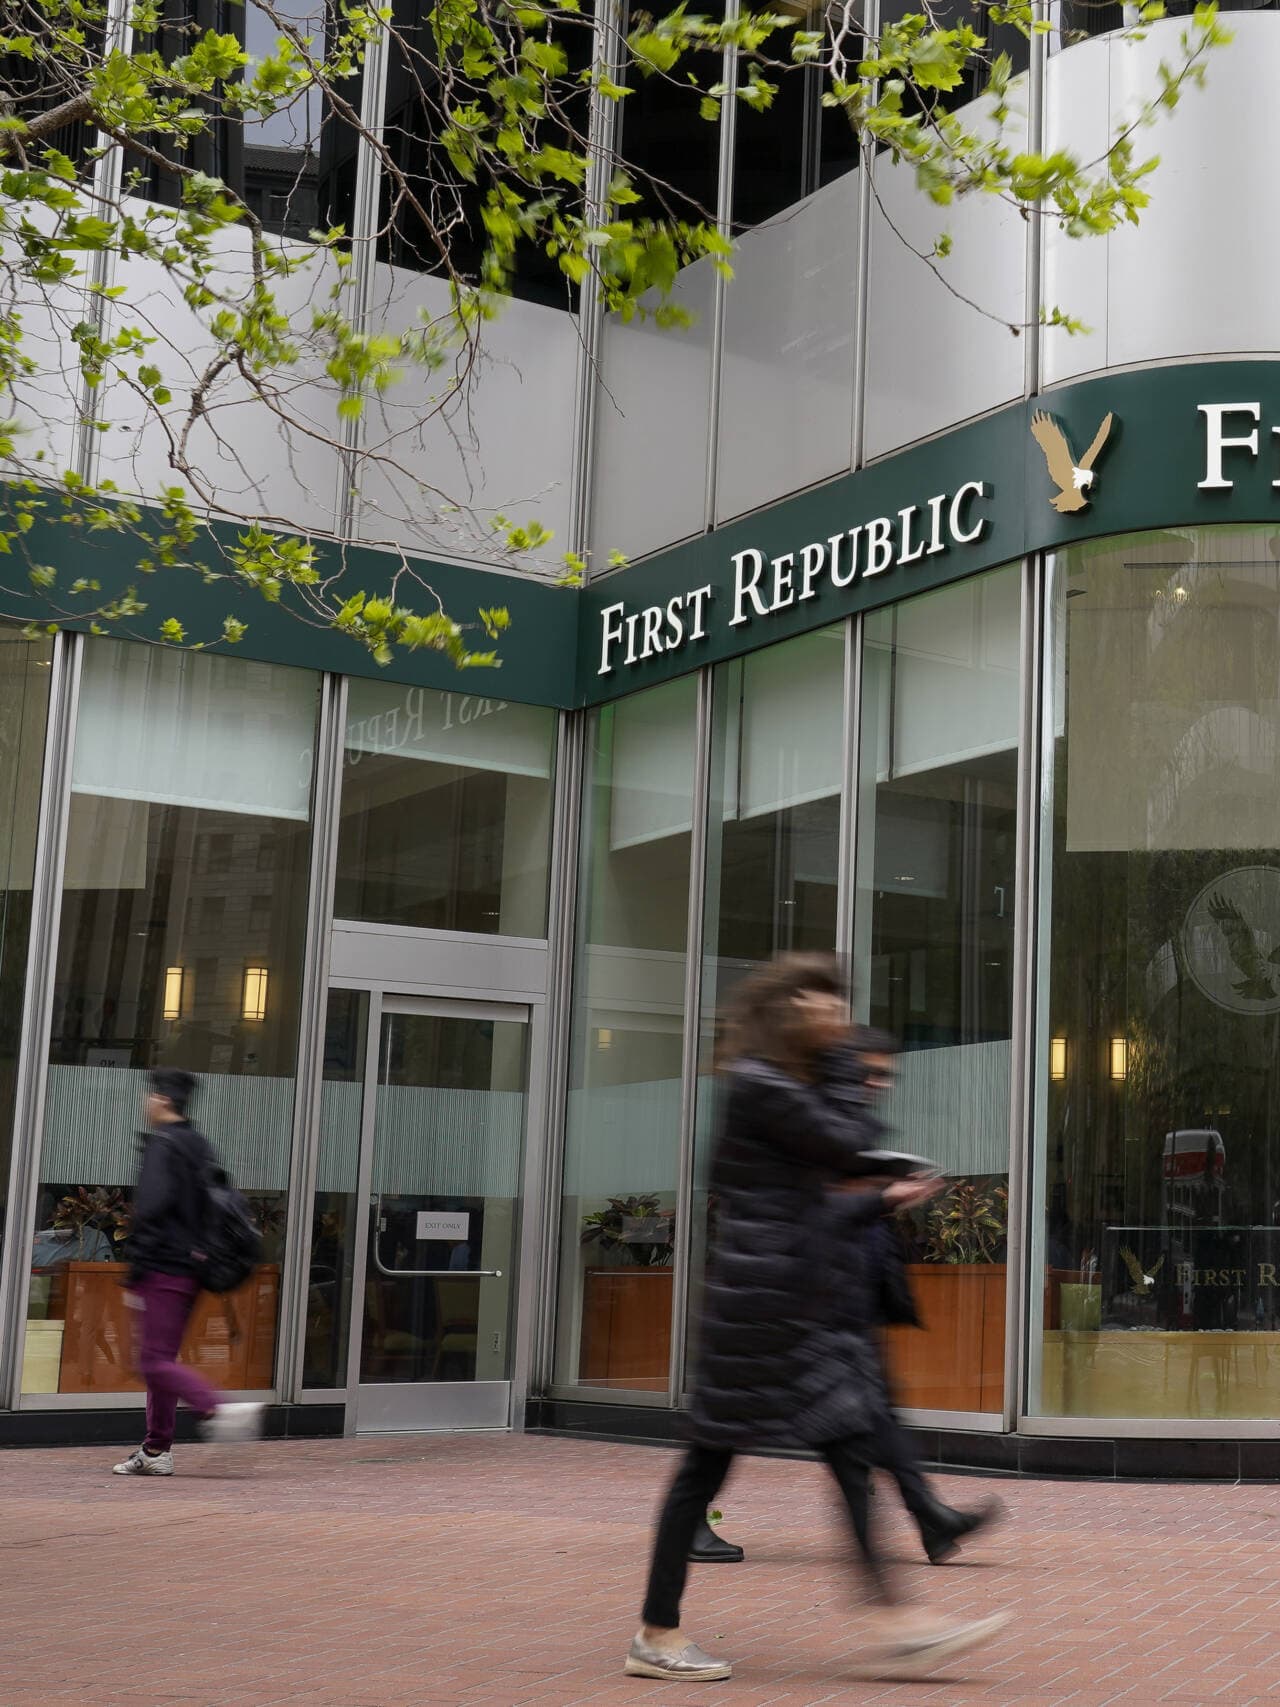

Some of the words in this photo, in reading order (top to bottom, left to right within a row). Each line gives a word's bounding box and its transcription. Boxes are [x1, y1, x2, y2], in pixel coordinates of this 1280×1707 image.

[596, 584, 713, 676] FIRST
[728, 480, 988, 627] REPUBLIC
[1174, 1263, 1246, 1286] FIRST
